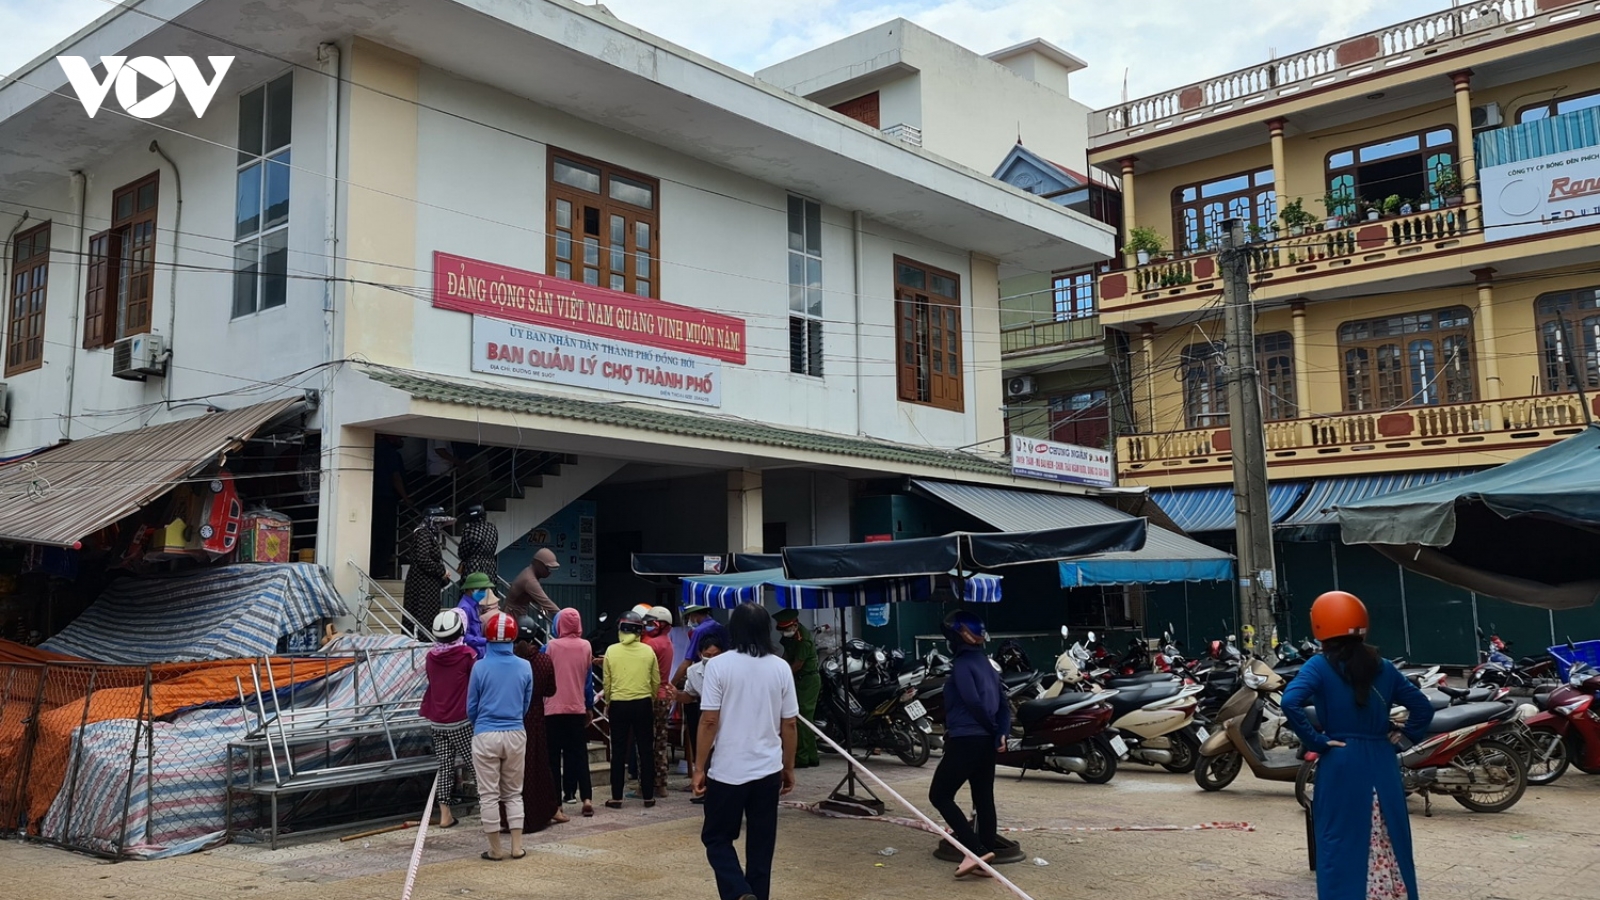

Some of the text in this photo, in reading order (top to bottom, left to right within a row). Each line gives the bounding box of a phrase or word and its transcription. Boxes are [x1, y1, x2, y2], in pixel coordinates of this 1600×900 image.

[1546, 161, 1564, 169] BÓNG
[1541, 209, 1575, 225] LED
[447, 263, 740, 351] ĐẢNG CỘNG SẢN VIỆT NAM QUANG VINH MUÔN NĂM!
[526, 331, 546, 342] BAN
[548, 334, 577, 348] NHÂN
[579, 339, 599, 351] DÂN
[601, 344, 634, 357] THÀNH
[636, 349, 653, 361] PHỐ
[655, 352, 678, 366] ĐỒNG
[487, 342, 713, 394] BAN QUẢN LÝ CHỢ THÀNH PHỐ
